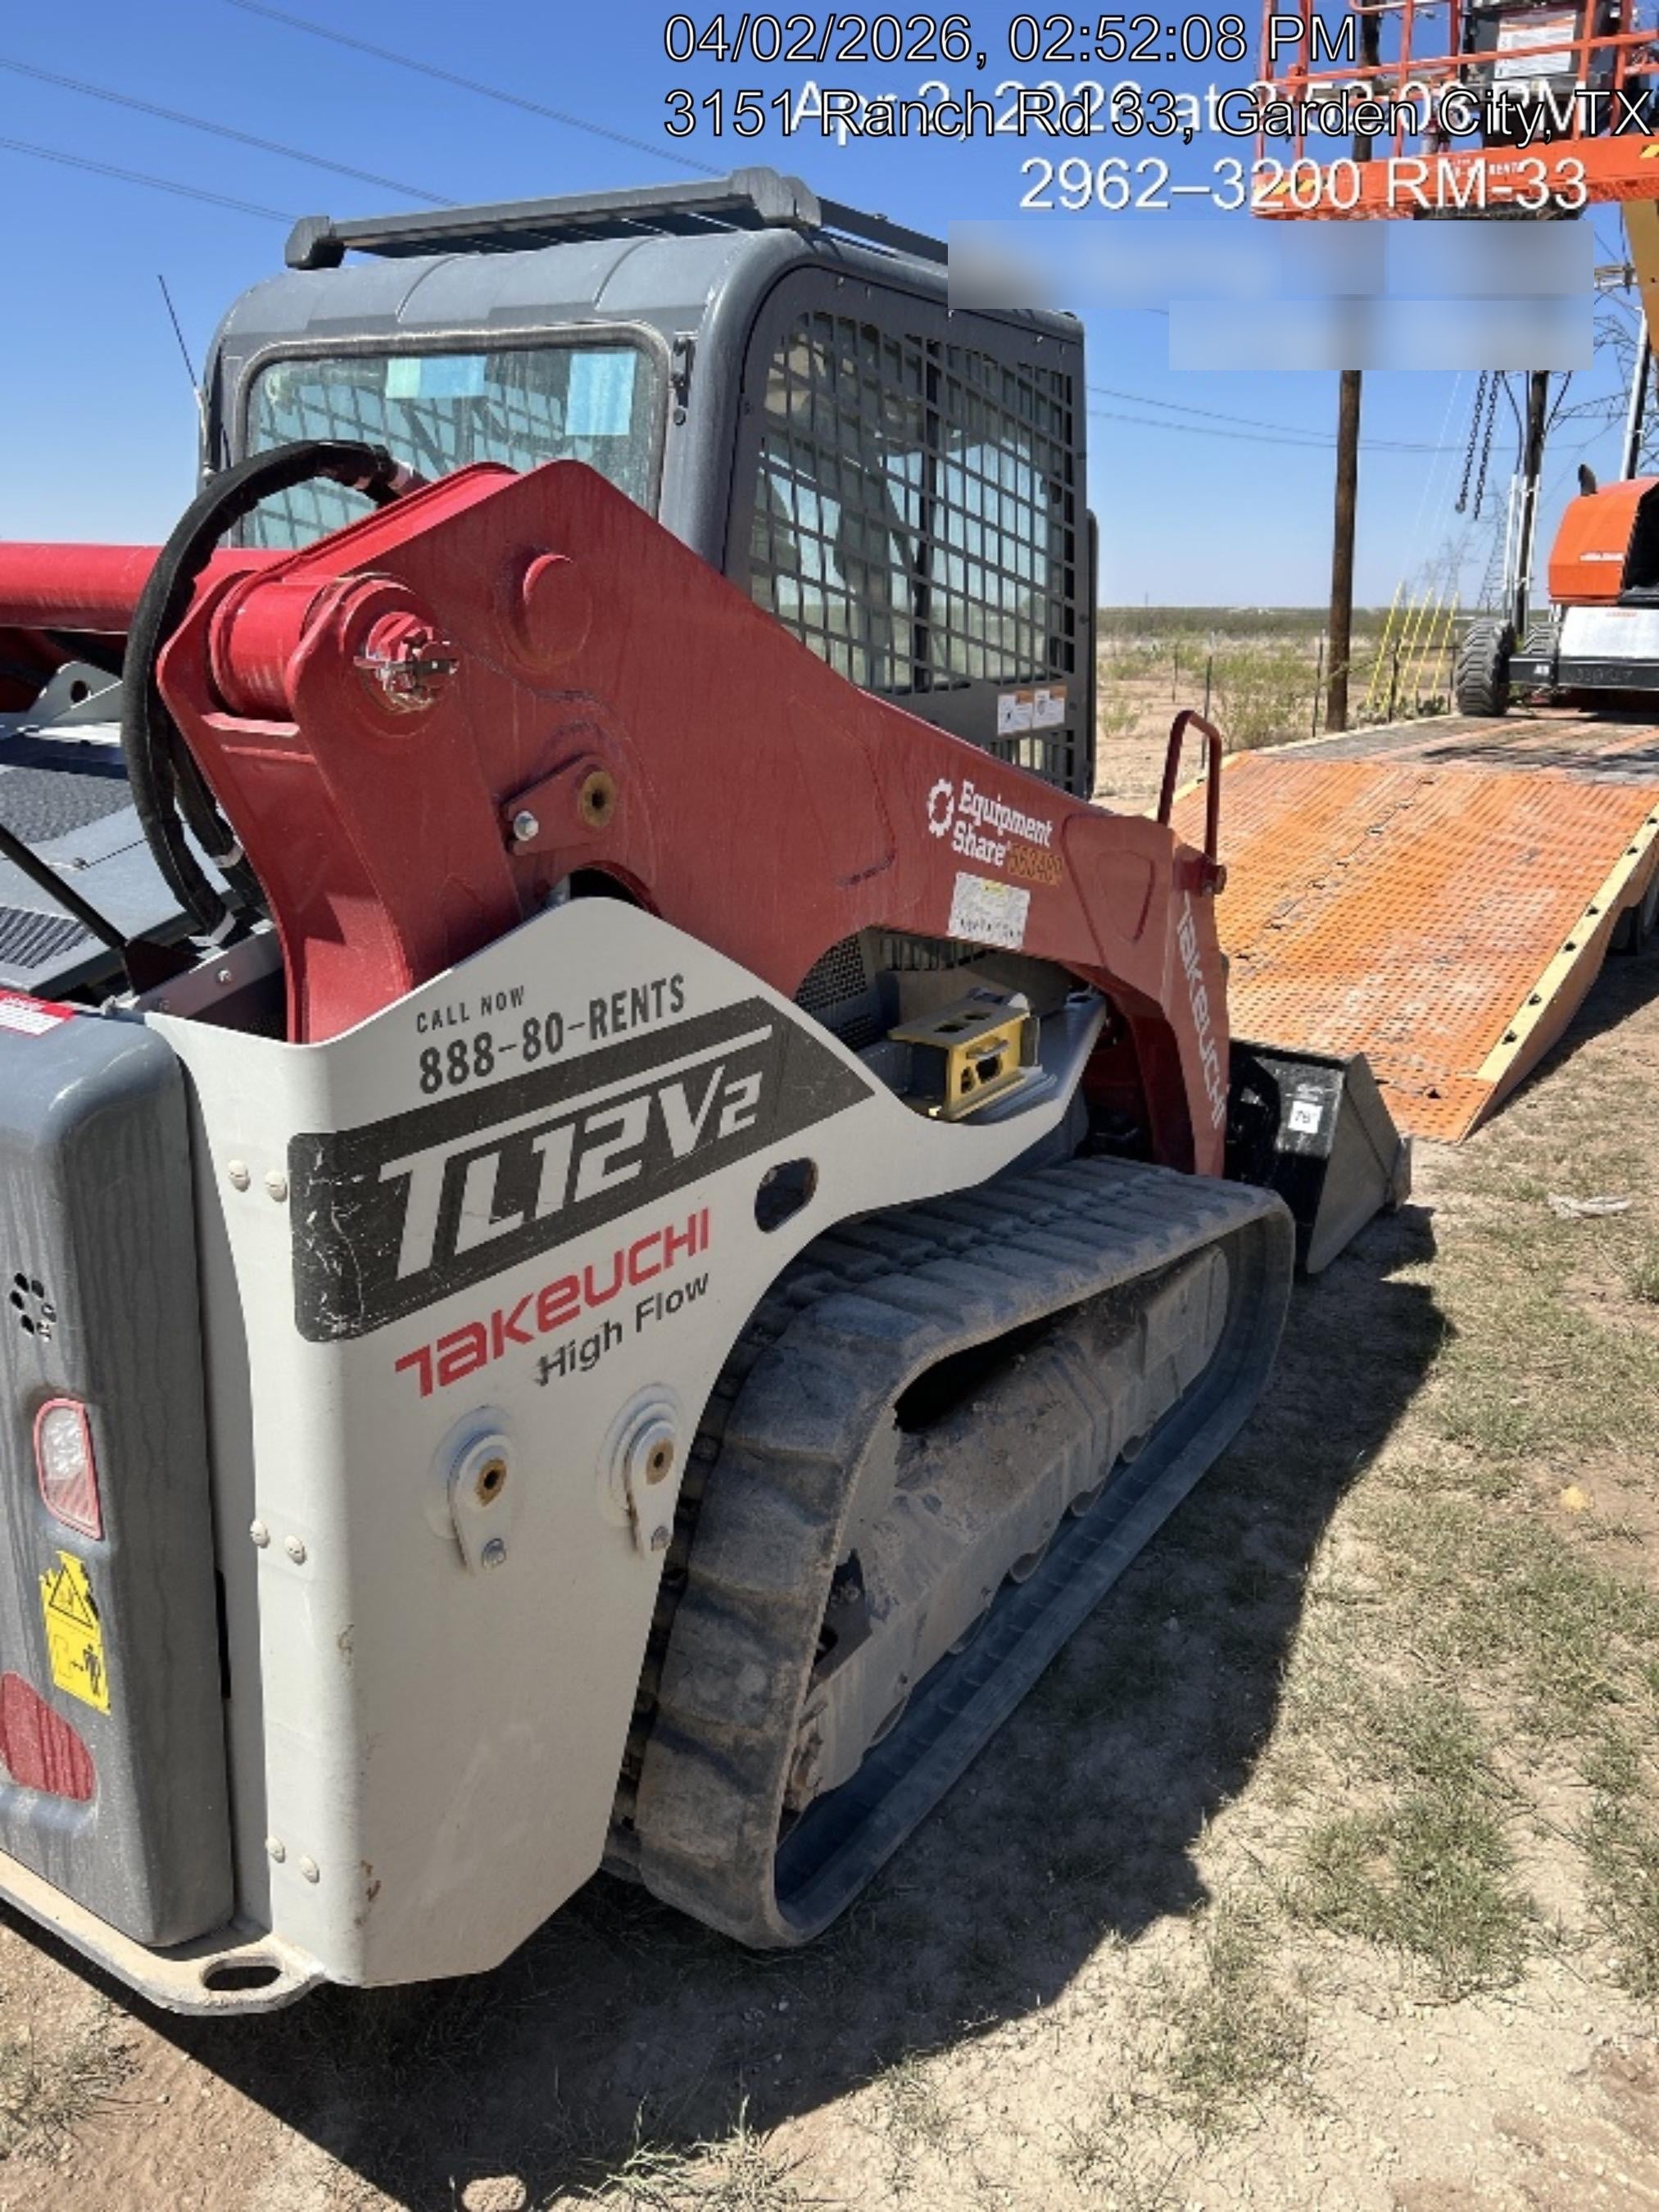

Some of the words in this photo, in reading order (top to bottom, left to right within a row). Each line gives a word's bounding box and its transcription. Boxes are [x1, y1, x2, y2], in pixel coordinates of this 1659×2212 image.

[958, 779, 1054, 848] Equipment
[416, 1002, 470, 1034] CALL
[480, 985, 525, 1017] NOW
[419, 973, 686, 1095] 888-80-RENTS
[533, 1320, 623, 1386] High
[635, 1272, 709, 1333] Flow
